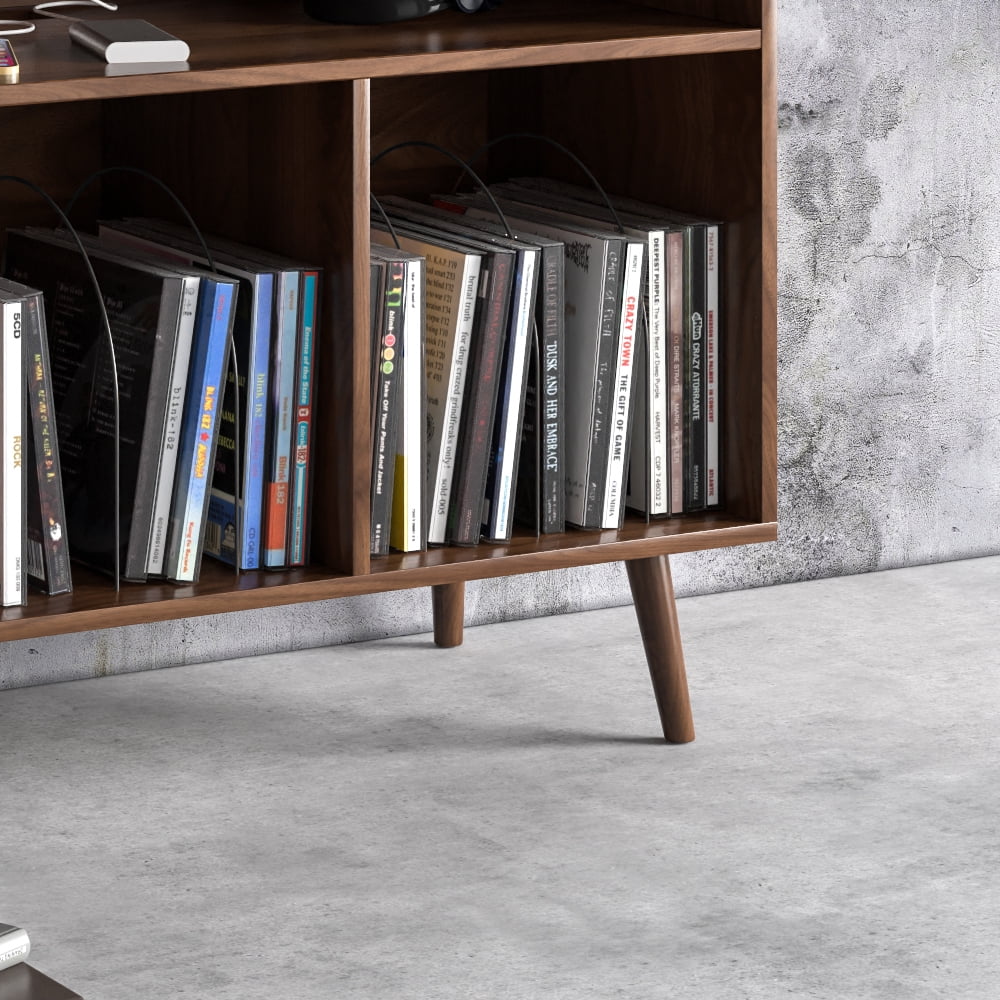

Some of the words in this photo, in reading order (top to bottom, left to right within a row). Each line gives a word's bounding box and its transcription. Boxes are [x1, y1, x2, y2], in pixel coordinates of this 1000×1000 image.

[465, 275, 476, 300] brutal
[463, 302, 472, 322] truth
[625, 296, 636, 331] CRAZY
[13, 312, 21, 339] 5CD
[461, 331, 469, 345] for
[303, 326, 311, 354] Enema
[621, 336, 632, 366] TOWN
[456, 346, 467, 366] drug
[692, 342, 700, 369] CRAZY
[256, 373, 265, 398] blink
[301, 381, 309, 404] State
[453, 368, 463, 395] crazed
[546, 375, 557, 396] AND
[619, 374, 628, 392] THE
[617, 396, 626, 416] GIFT
[692, 371, 700, 421] ATORRANTE
[166, 387, 181, 450] blink-182
[447, 396, 460, 444] grindfreaks
[546, 400, 557, 419] HER
[616, 419, 624, 432] OF
[13, 436, 21, 468] ROCK
[613, 434, 622, 461] GAME
[278, 456, 287, 481] Blink
[276, 484, 286, 504] 182
[609, 480, 617, 517] COLUMBIA
